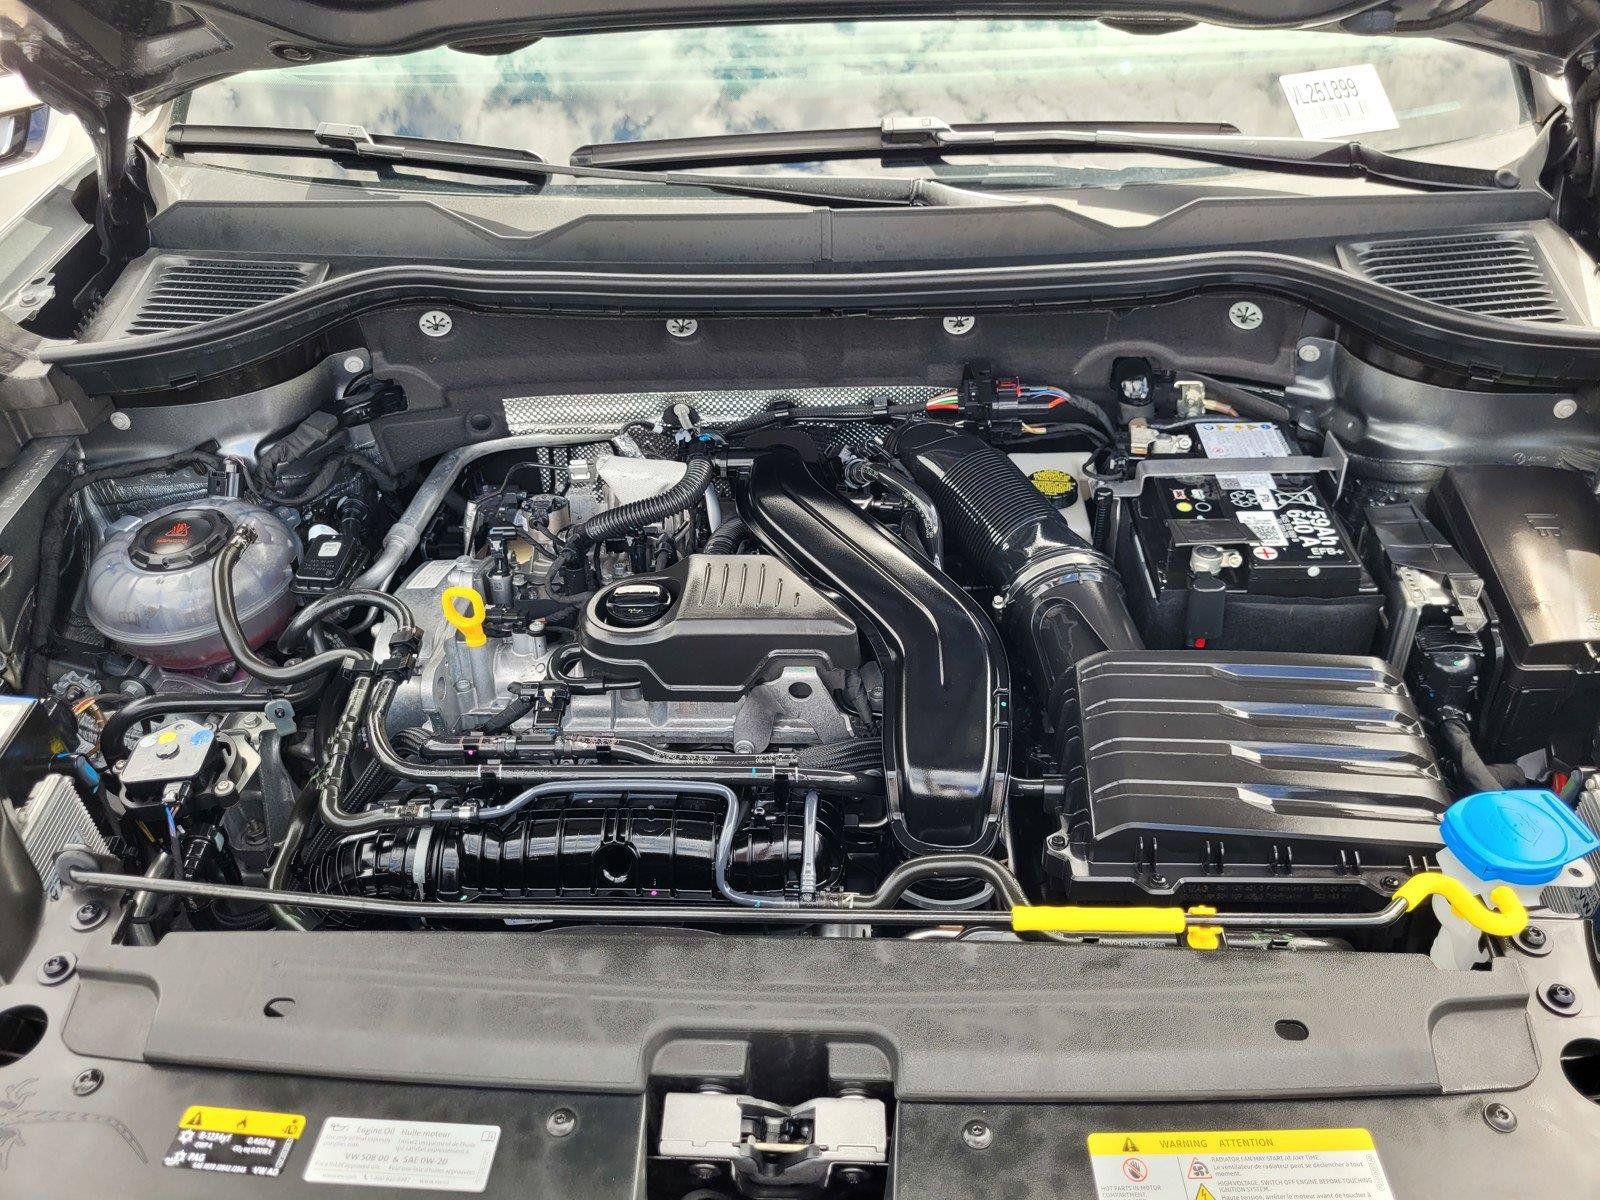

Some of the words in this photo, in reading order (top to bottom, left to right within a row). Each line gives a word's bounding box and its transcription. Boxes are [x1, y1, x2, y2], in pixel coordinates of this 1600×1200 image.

[1286, 509, 1315, 534] 640
[1298, 535, 1321, 548] A
[1159, 1139, 1208, 1149] WARNING
[1219, 1138, 1275, 1148] ATTENTION
